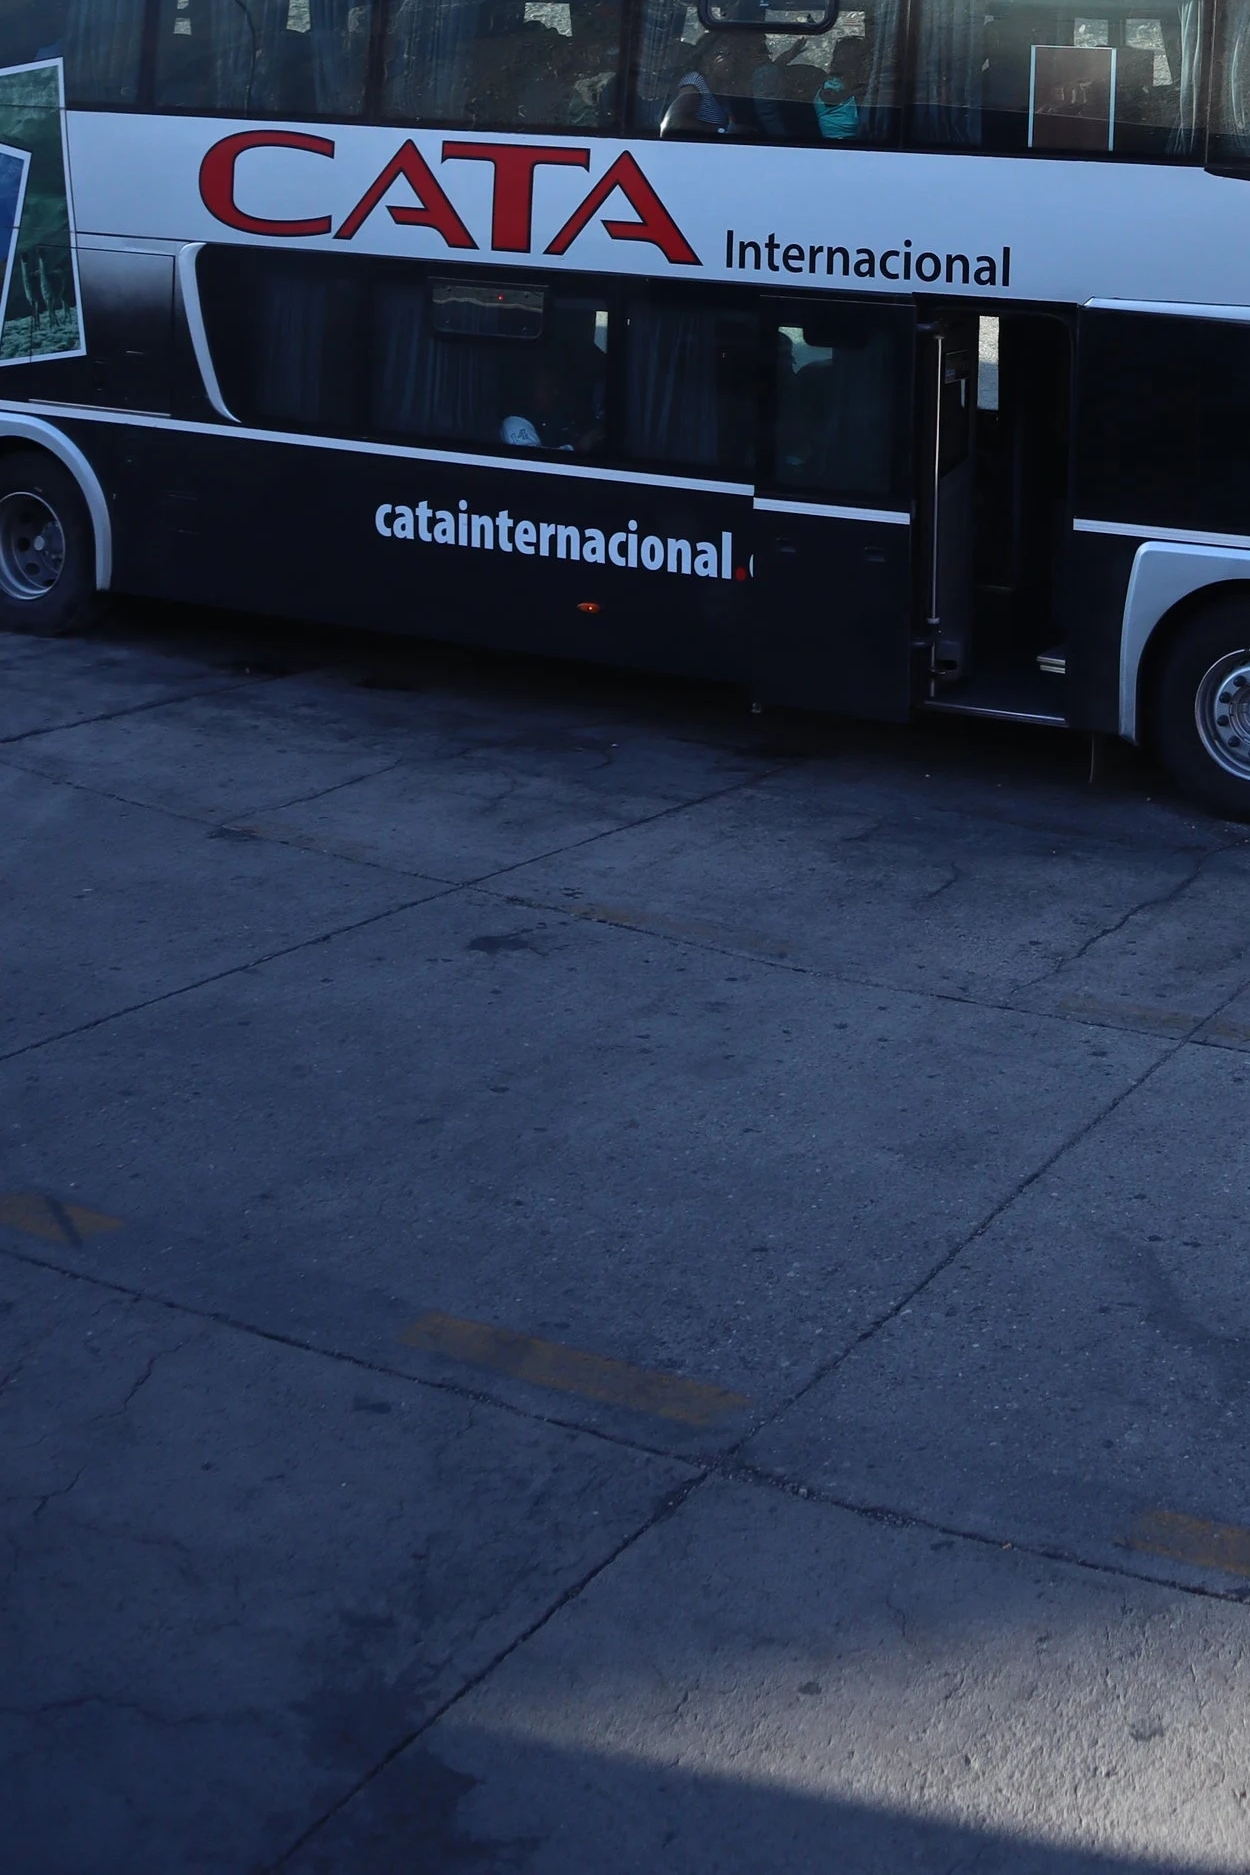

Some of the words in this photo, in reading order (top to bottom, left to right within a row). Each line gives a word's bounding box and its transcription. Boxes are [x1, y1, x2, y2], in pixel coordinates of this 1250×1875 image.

[198, 129, 704, 266] CATA
[725, 230, 1012, 287] Internacional
[375, 499, 754, 581] catainternacional.
